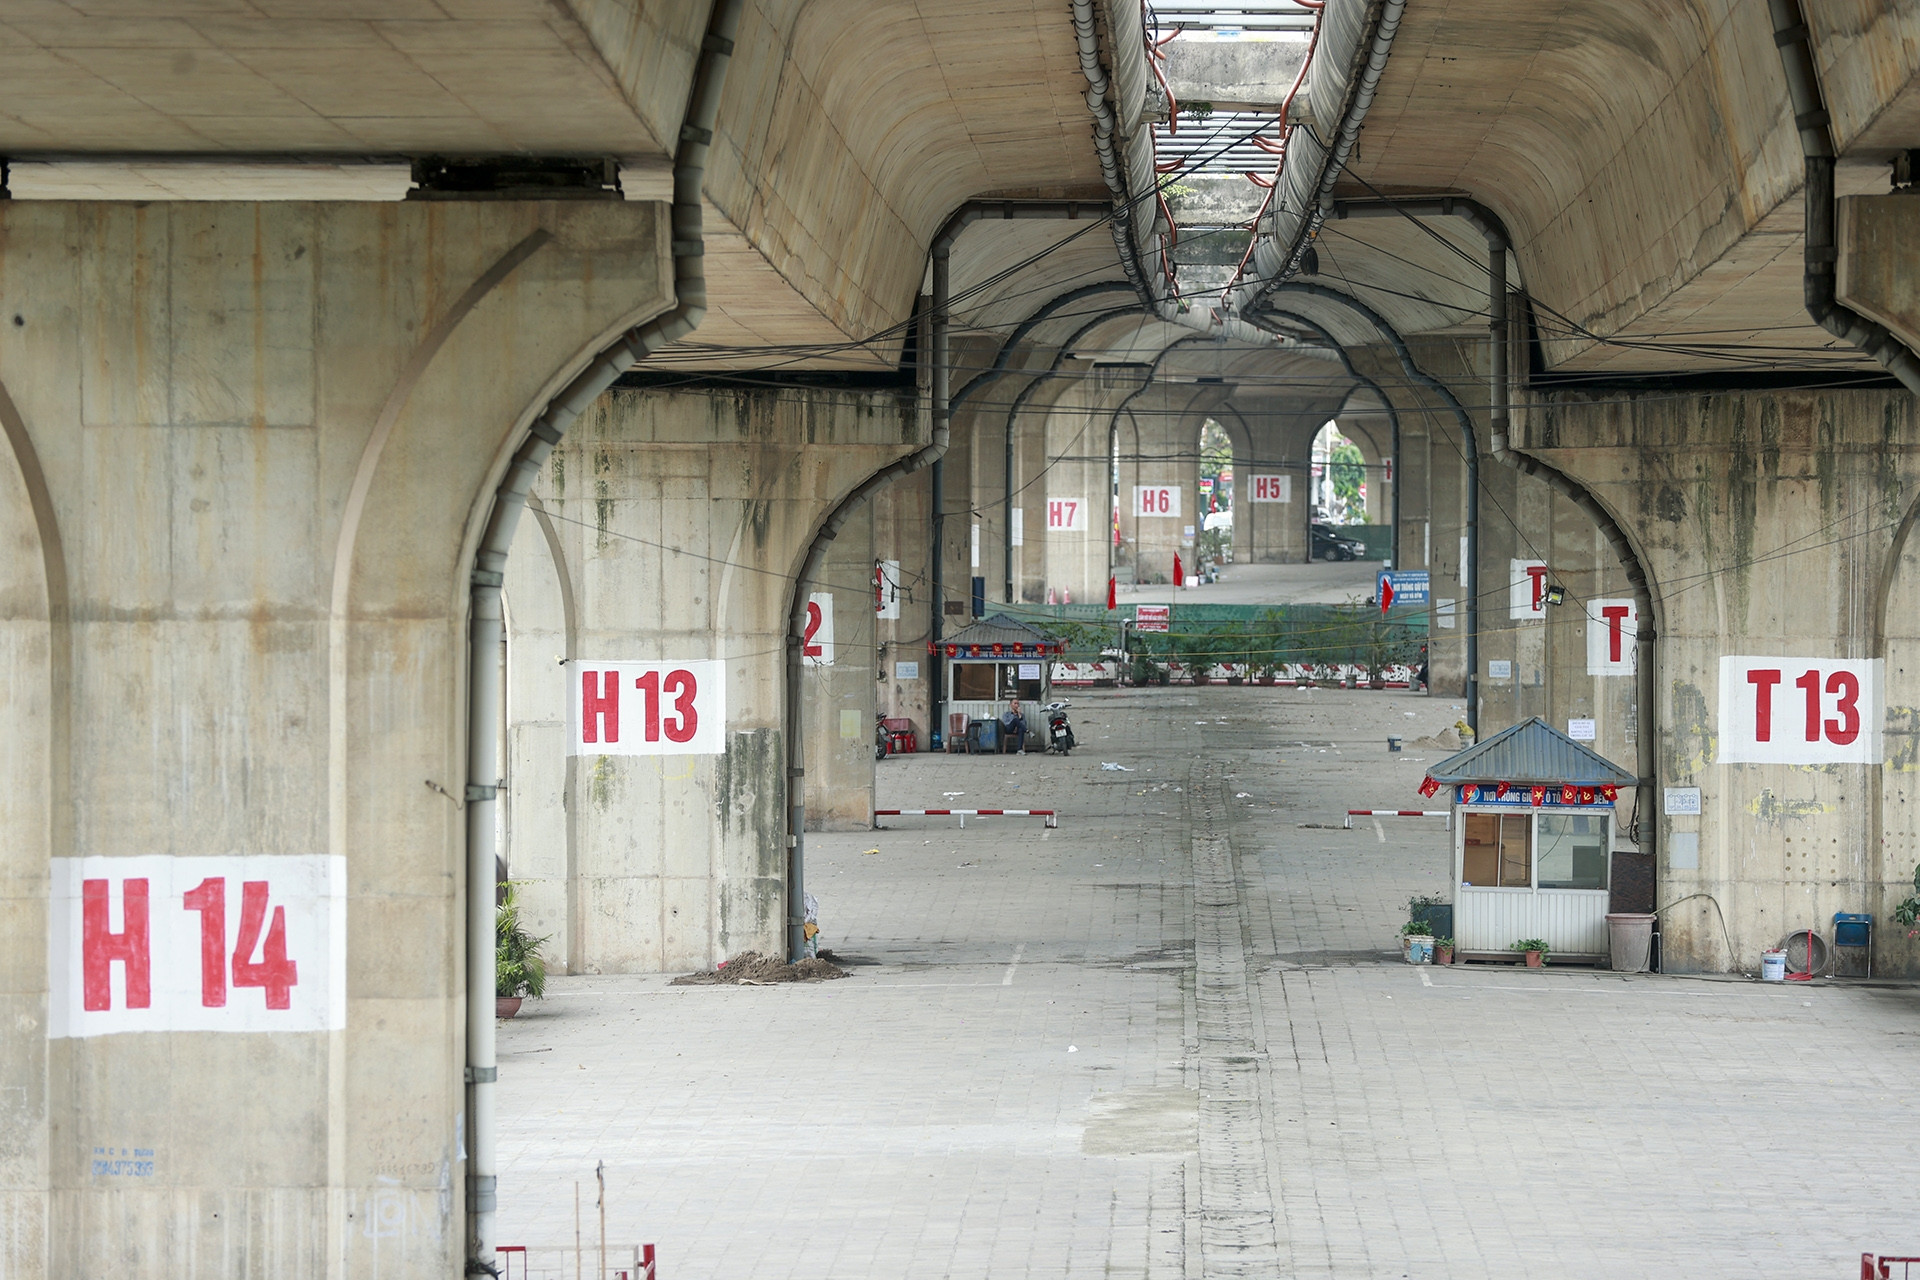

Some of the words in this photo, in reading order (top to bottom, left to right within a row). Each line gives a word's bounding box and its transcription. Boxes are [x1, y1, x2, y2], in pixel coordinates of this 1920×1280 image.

[1049, 501, 1077, 527] H7
[1143, 489, 1169, 513] H6
[1256, 478, 1281, 499] H5
[1602, 606, 1629, 662] T
[582, 670, 620, 743] H
[635, 669, 699, 743] 13
[1747, 669, 1782, 742] T
[1795, 669, 1861, 746] 13
[82, 878, 151, 1012] H
[183, 877, 298, 1010] 14
